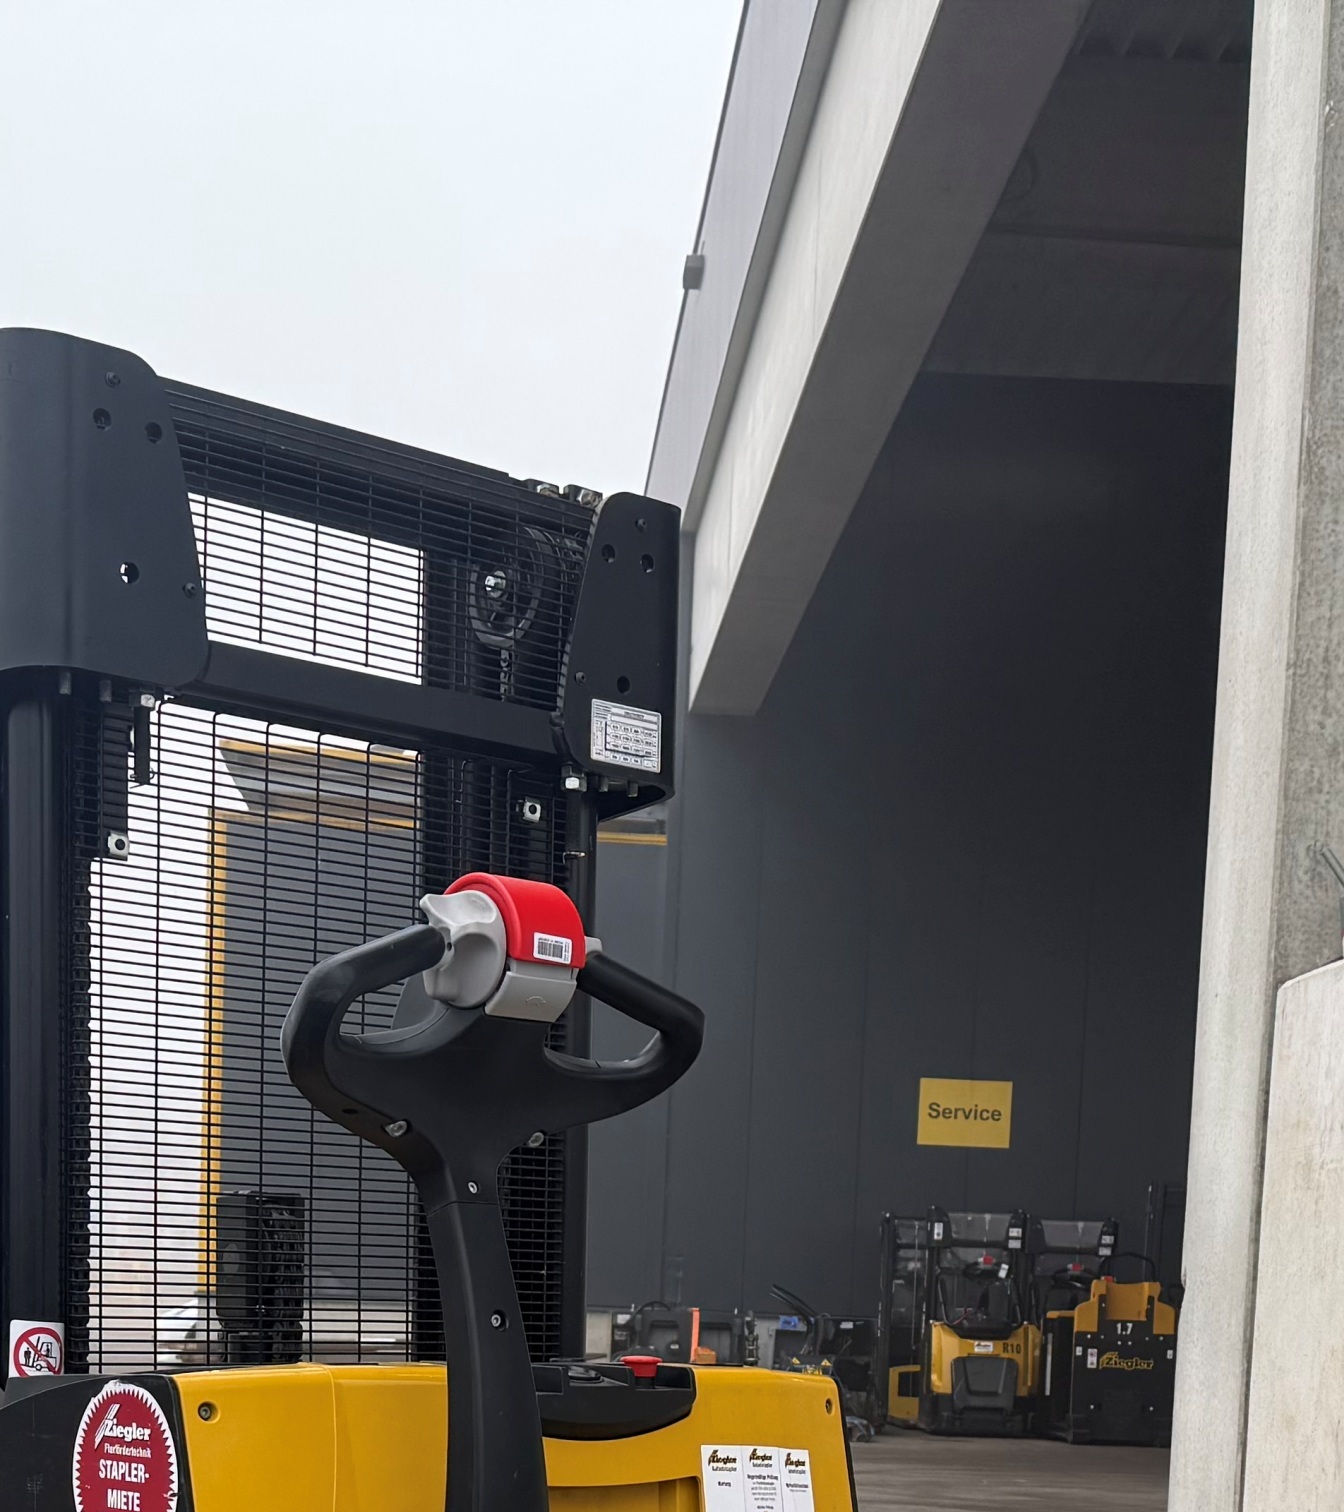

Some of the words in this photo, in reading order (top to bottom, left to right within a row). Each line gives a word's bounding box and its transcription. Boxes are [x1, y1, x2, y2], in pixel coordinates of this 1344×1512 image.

[927, 1102, 1002, 1122] Service
[1116, 1322, 1133, 1335] 1.7
[1002, 1342, 1021, 1354] R10
[1103, 1354, 1154, 1371] Ziegler
[103, 1418, 152, 1443] Ziegler
[99, 1459, 150, 1484] STAPLER-
[107, 1489, 141, 1512] MIETE
